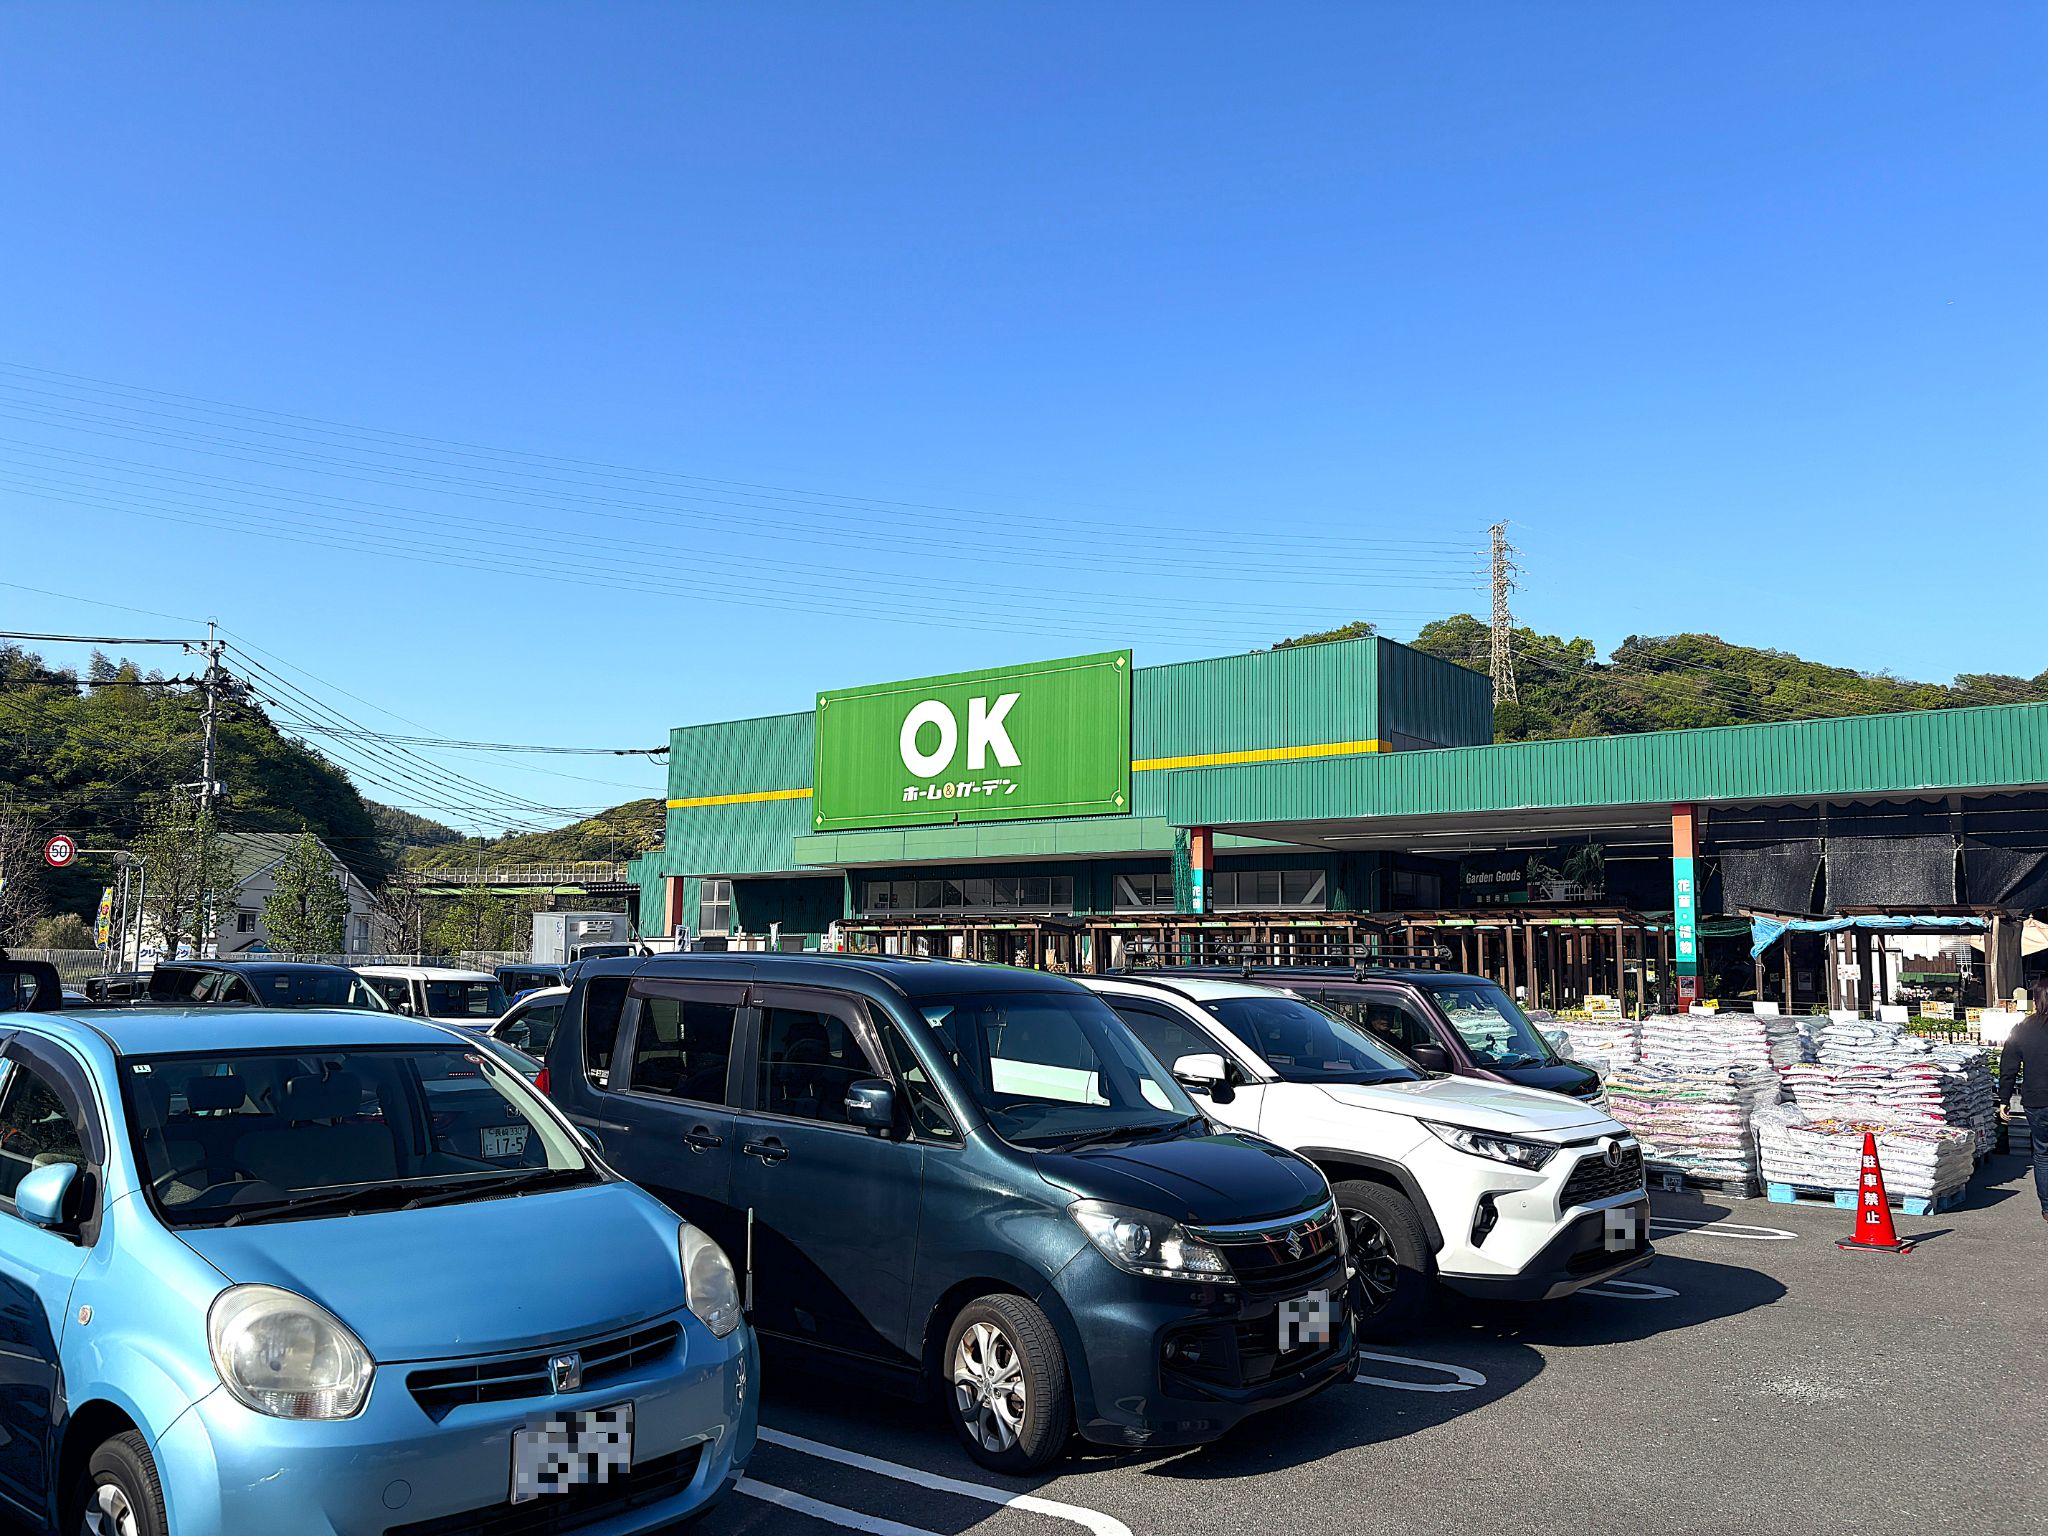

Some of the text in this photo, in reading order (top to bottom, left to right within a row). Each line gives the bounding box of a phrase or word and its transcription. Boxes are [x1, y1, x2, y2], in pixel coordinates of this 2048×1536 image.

[900, 692, 1022, 779] OK
[902, 779, 1019, 802] ホーム&ガーデン
[52, 845, 67, 858] 50
[1466, 870, 1521, 884] Garden Goods
[510, 1126, 522, 1136] 330
[496, 1136, 527, 1154] 17-5
[1862, 1154, 1881, 1224] 駐車禁止
